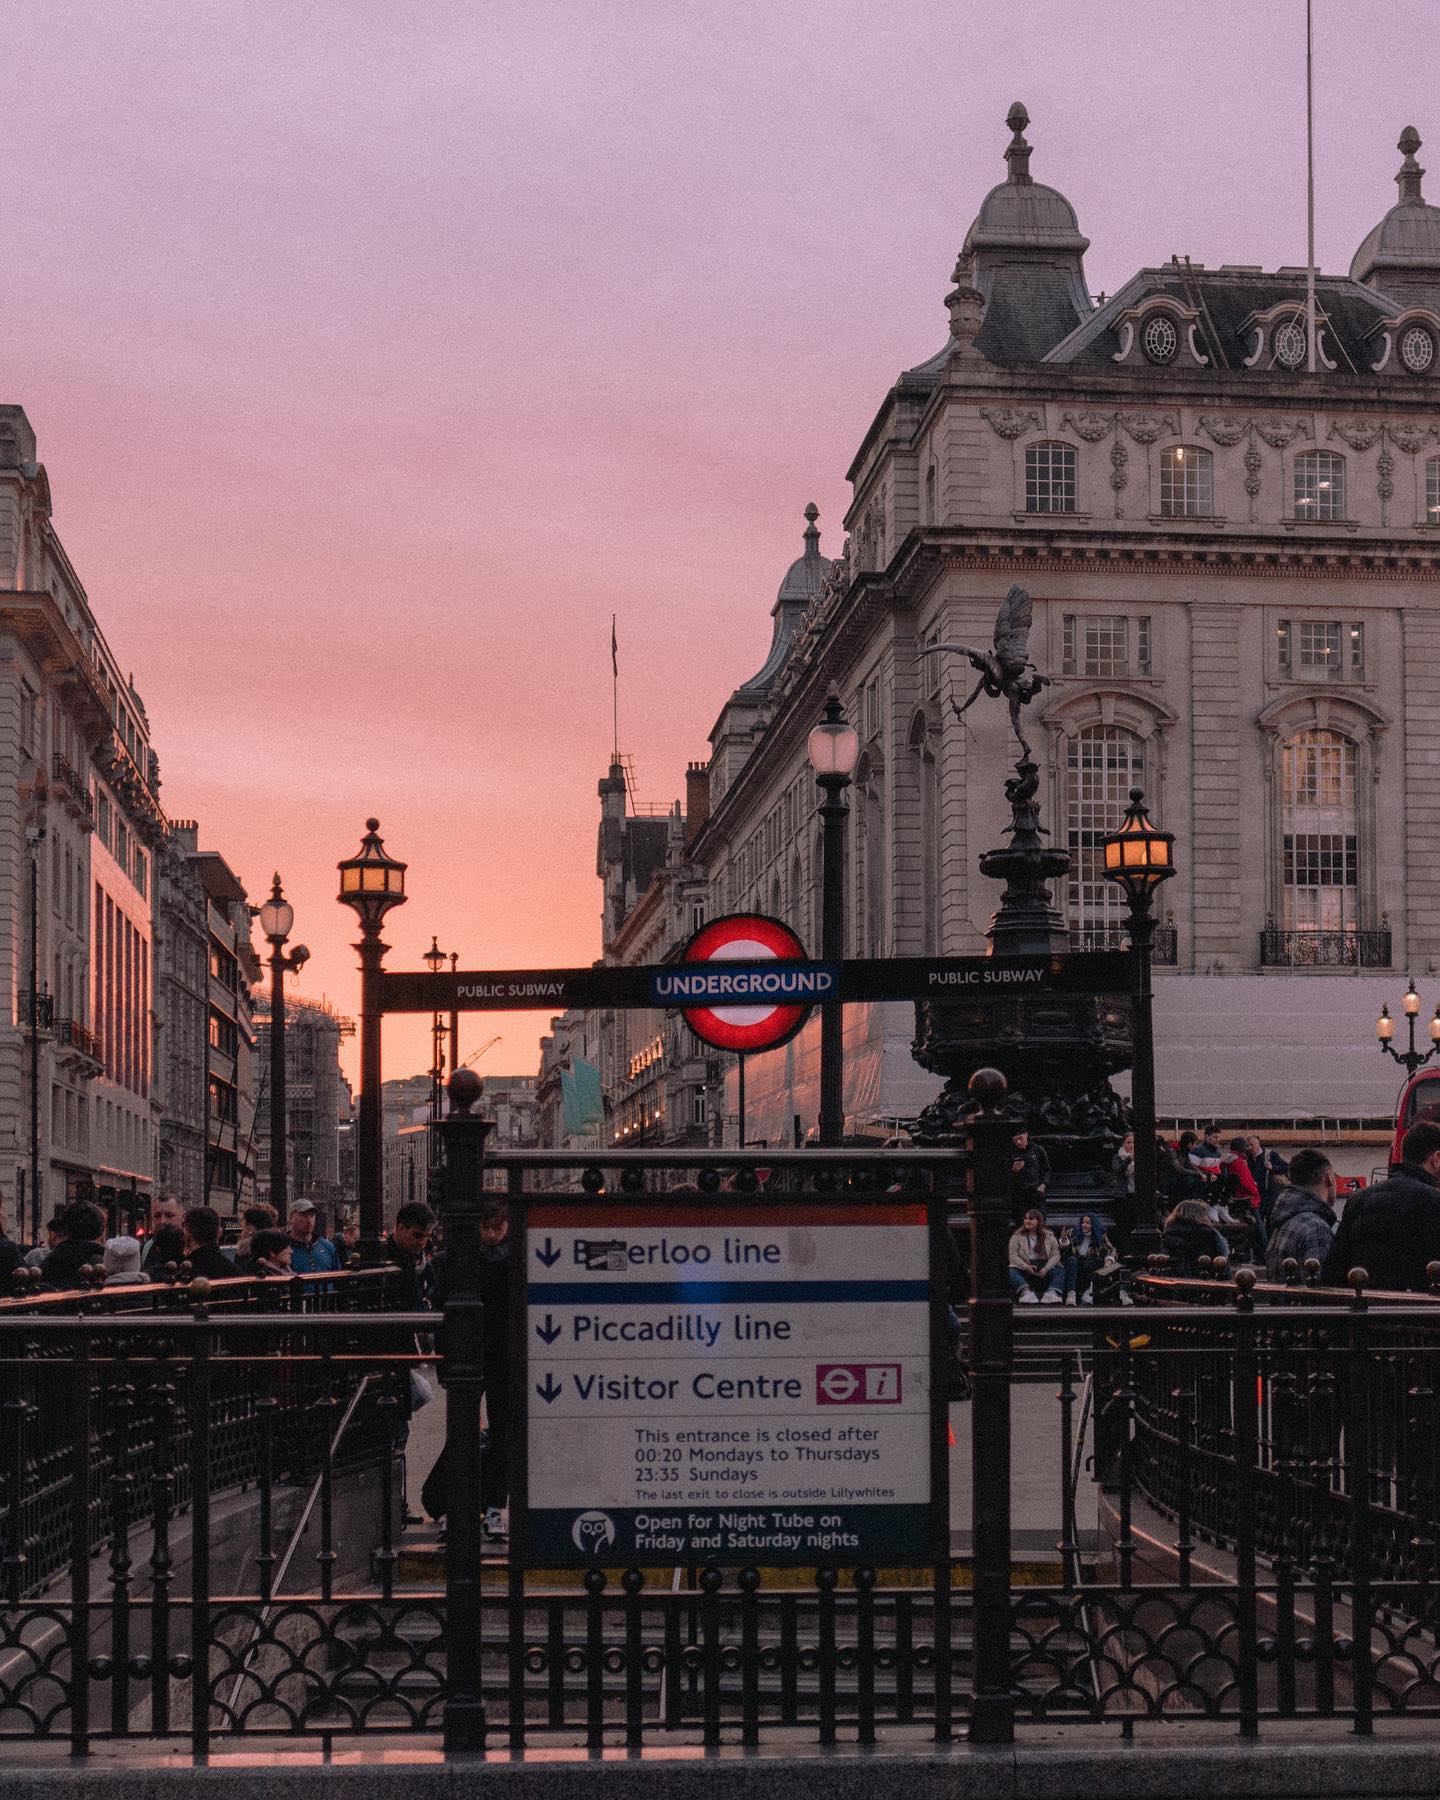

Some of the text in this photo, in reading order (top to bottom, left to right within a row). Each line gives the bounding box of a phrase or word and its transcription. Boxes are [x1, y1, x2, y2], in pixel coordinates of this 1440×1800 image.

[656, 972, 832, 995] UNDERGROUND
[929, 969, 1044, 985] PUBLIC SUBWAY
[457, 983, 564, 998] PUBLIC SUBWAY
[573, 1239, 780, 1265] Berloo line
[573, 1314, 791, 1347] Piccadilly line
[573, 1373, 802, 1400] Visitor Centre
[635, 1428, 879, 1443] This entrance is closed after
[635, 1447, 880, 1464] 00:20 Mondays to Thursdays
[635, 1468, 758, 1483] 23:35 Sundays
[635, 1487, 894, 1500] The last exit to close is outside Lillywhites
[635, 1513, 841, 1532] Open for Night Tube on
[635, 1532, 859, 1552] Friday and Saturday nights
